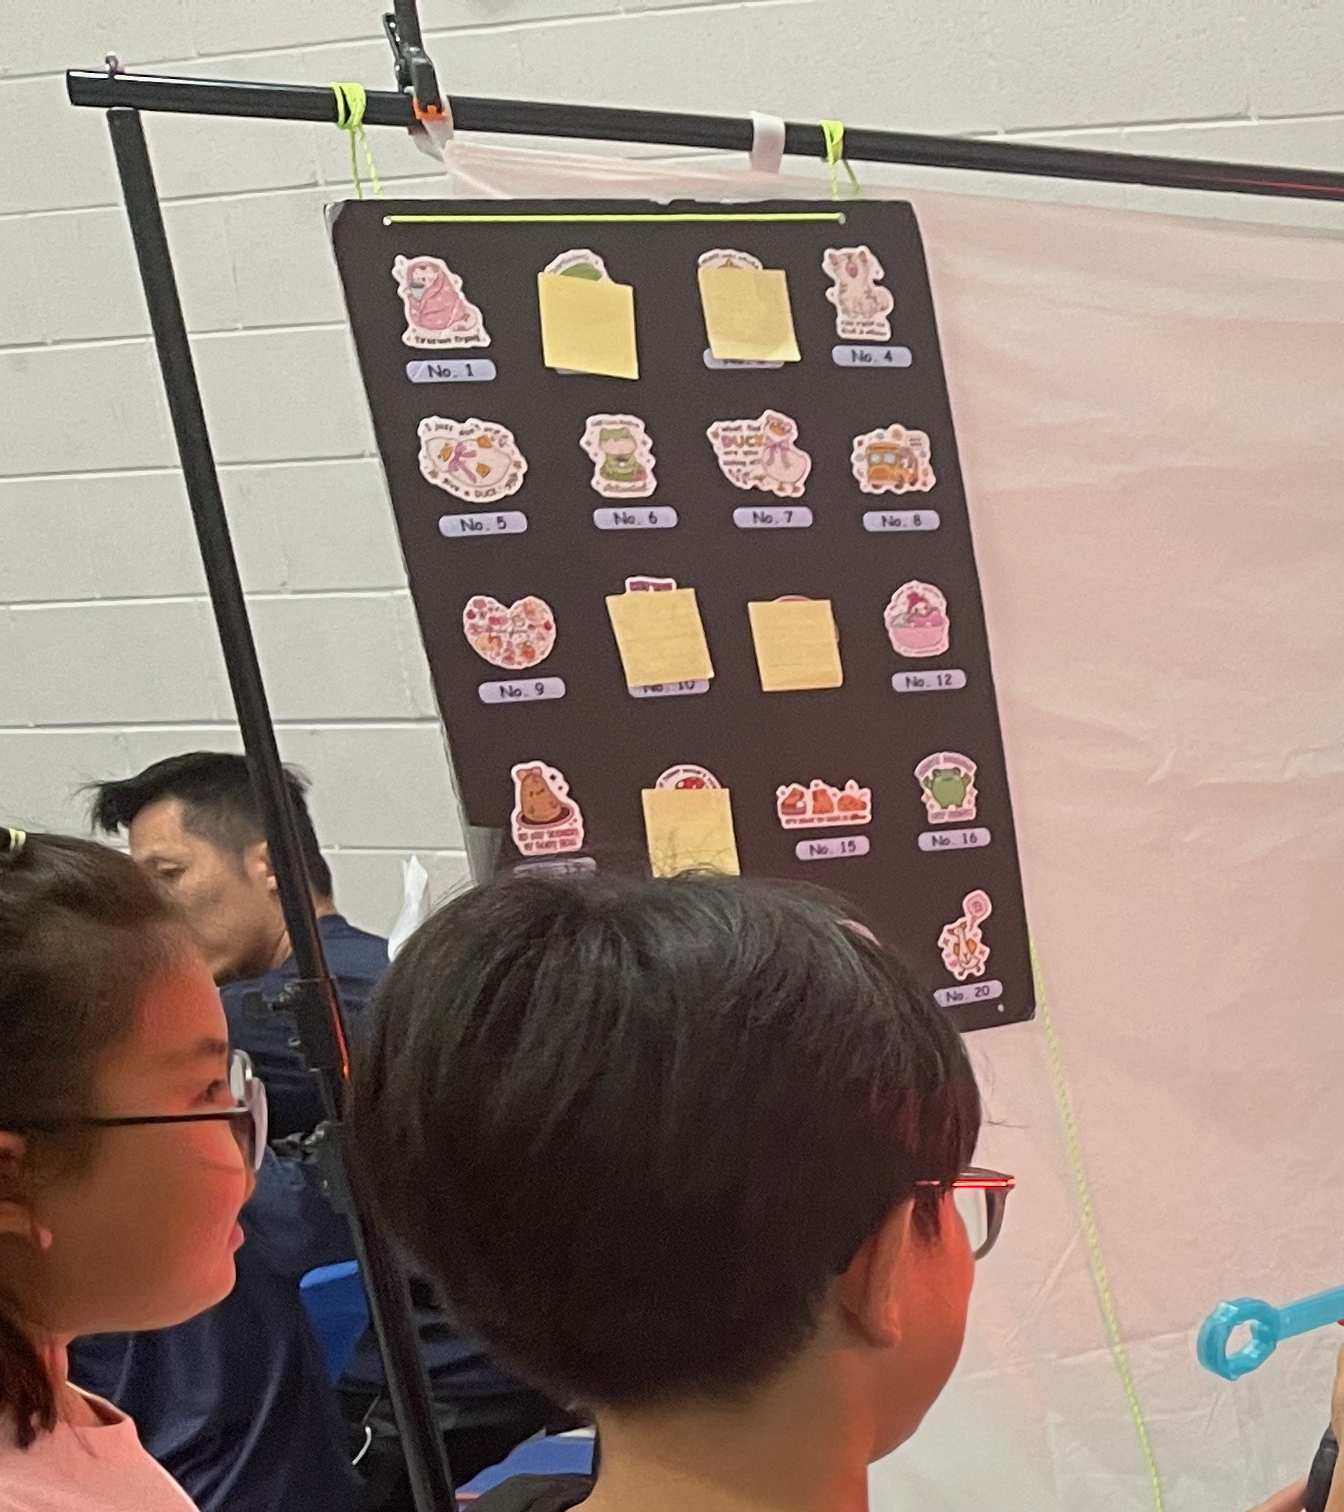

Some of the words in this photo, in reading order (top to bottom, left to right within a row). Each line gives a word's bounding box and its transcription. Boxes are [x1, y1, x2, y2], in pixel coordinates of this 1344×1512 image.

[884, 350, 893, 363] 4
[466, 363, 474, 377] 1
[496, 516, 507, 530] 5
[648, 511, 658, 524] 6
[783, 510, 793, 523] 7
[913, 513, 922, 526] 8
[936, 673, 953, 686] 12
[535, 682, 545, 695] 9
[962, 832, 978, 844] 16
[840, 840, 857, 853] 15
[974, 985, 990, 998] 20
